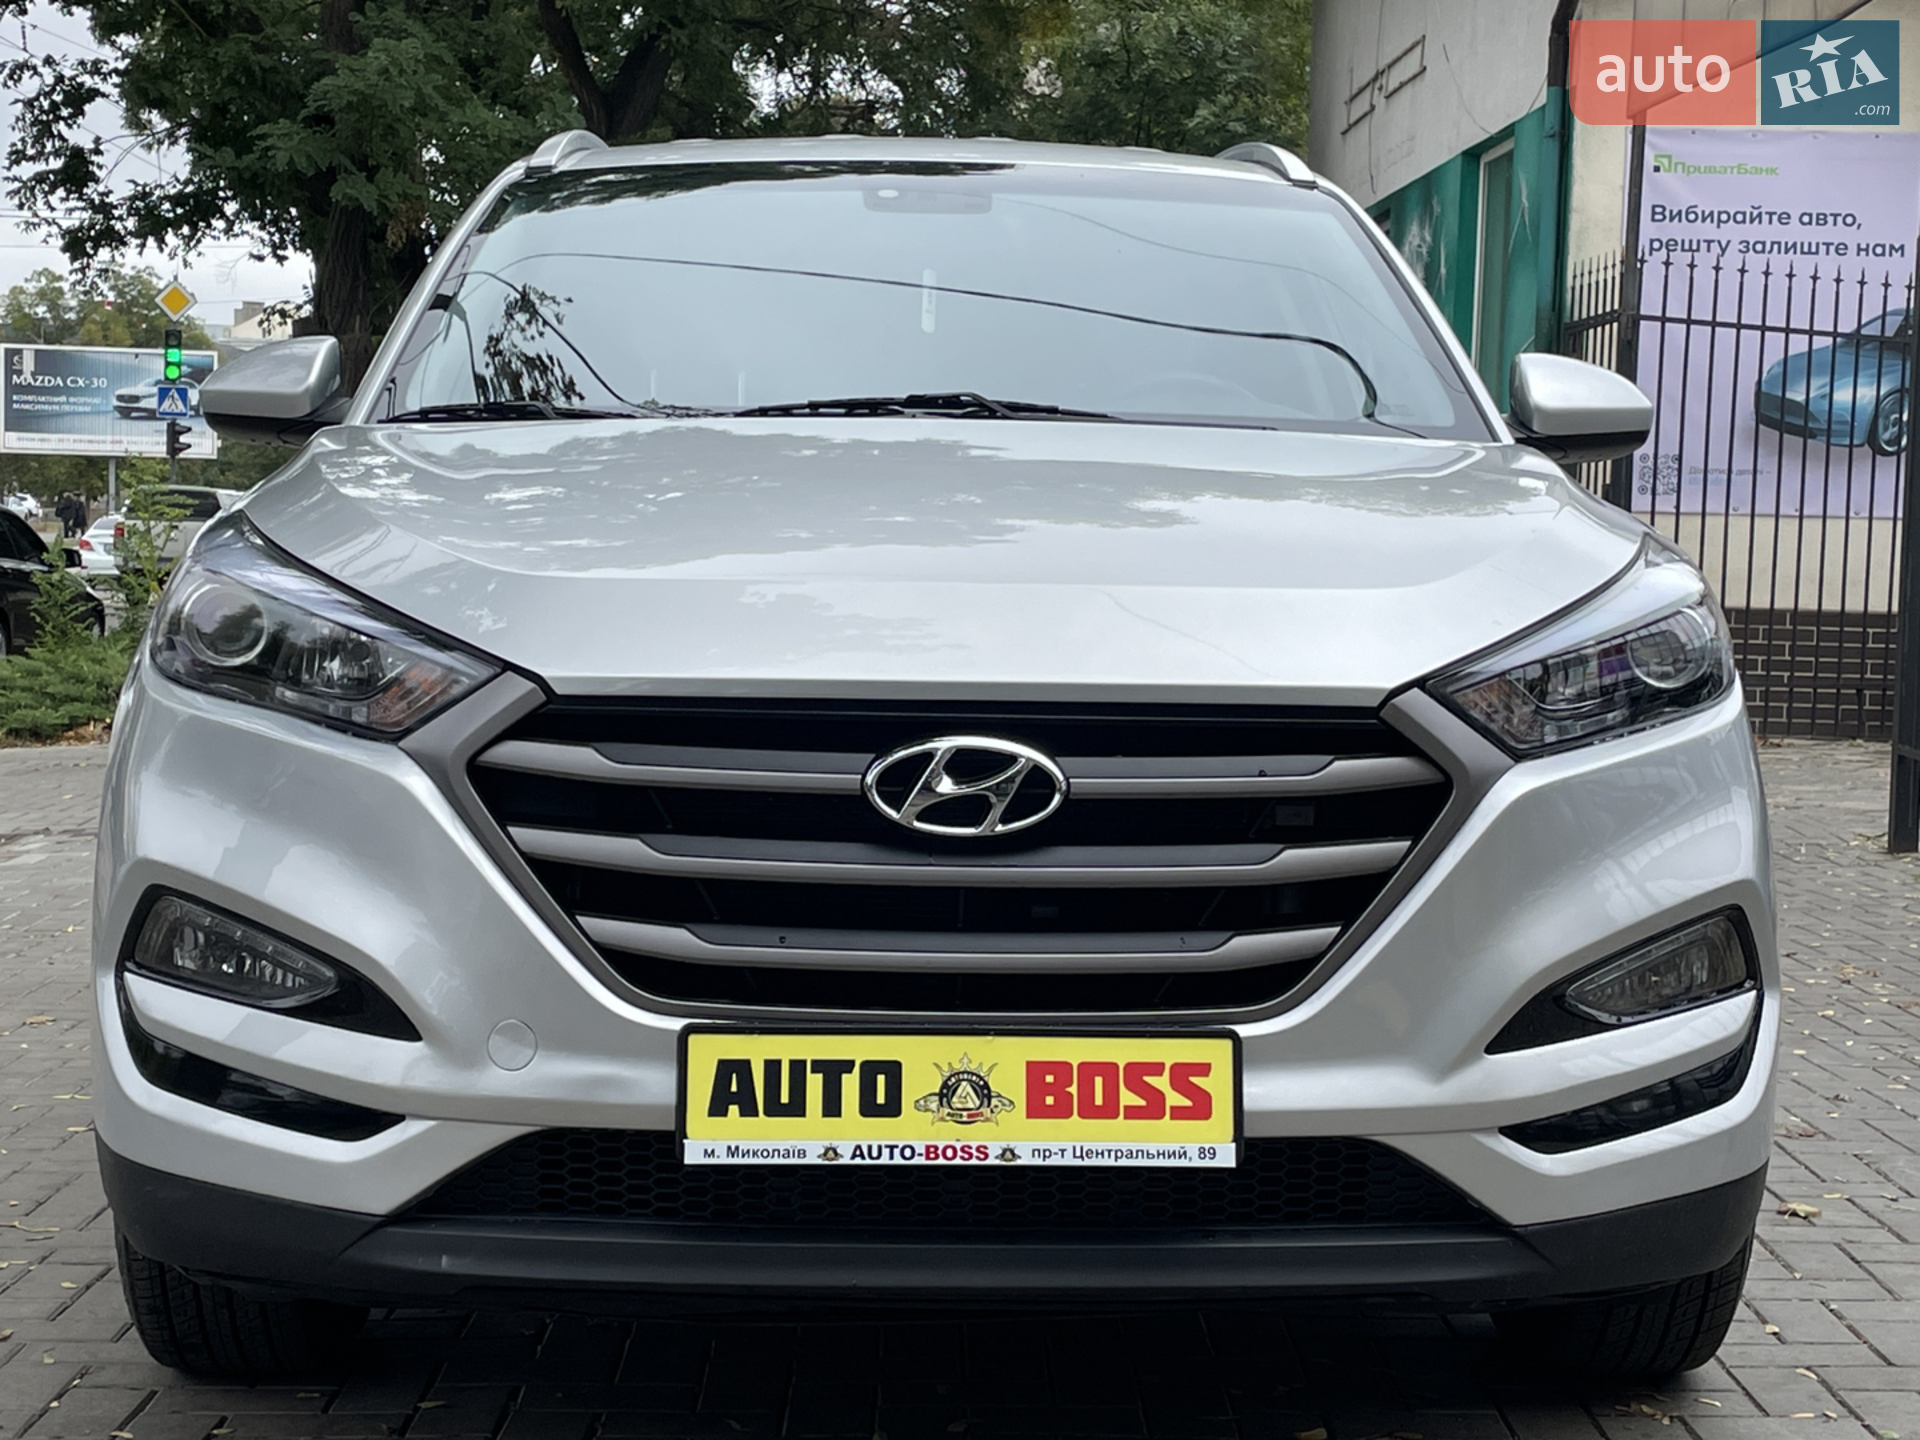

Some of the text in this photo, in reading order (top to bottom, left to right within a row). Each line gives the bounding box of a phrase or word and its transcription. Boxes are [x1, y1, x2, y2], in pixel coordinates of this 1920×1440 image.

[1673, 161, 1780, 177] ПриватБанк
[1650, 204, 1863, 230] Вибирайте авто,
[1648, 237, 1906, 258] решту залиште нам
[12, 374, 108, 388] MAZDA CX-30
[707, 1058, 1213, 1121] AUTO BOSS
[703, 1145, 807, 1160] м. Миколаїв
[850, 1144, 990, 1162] AUTO-BOSS
[1031, 1146, 1217, 1162] пр-т Центральний, 89
